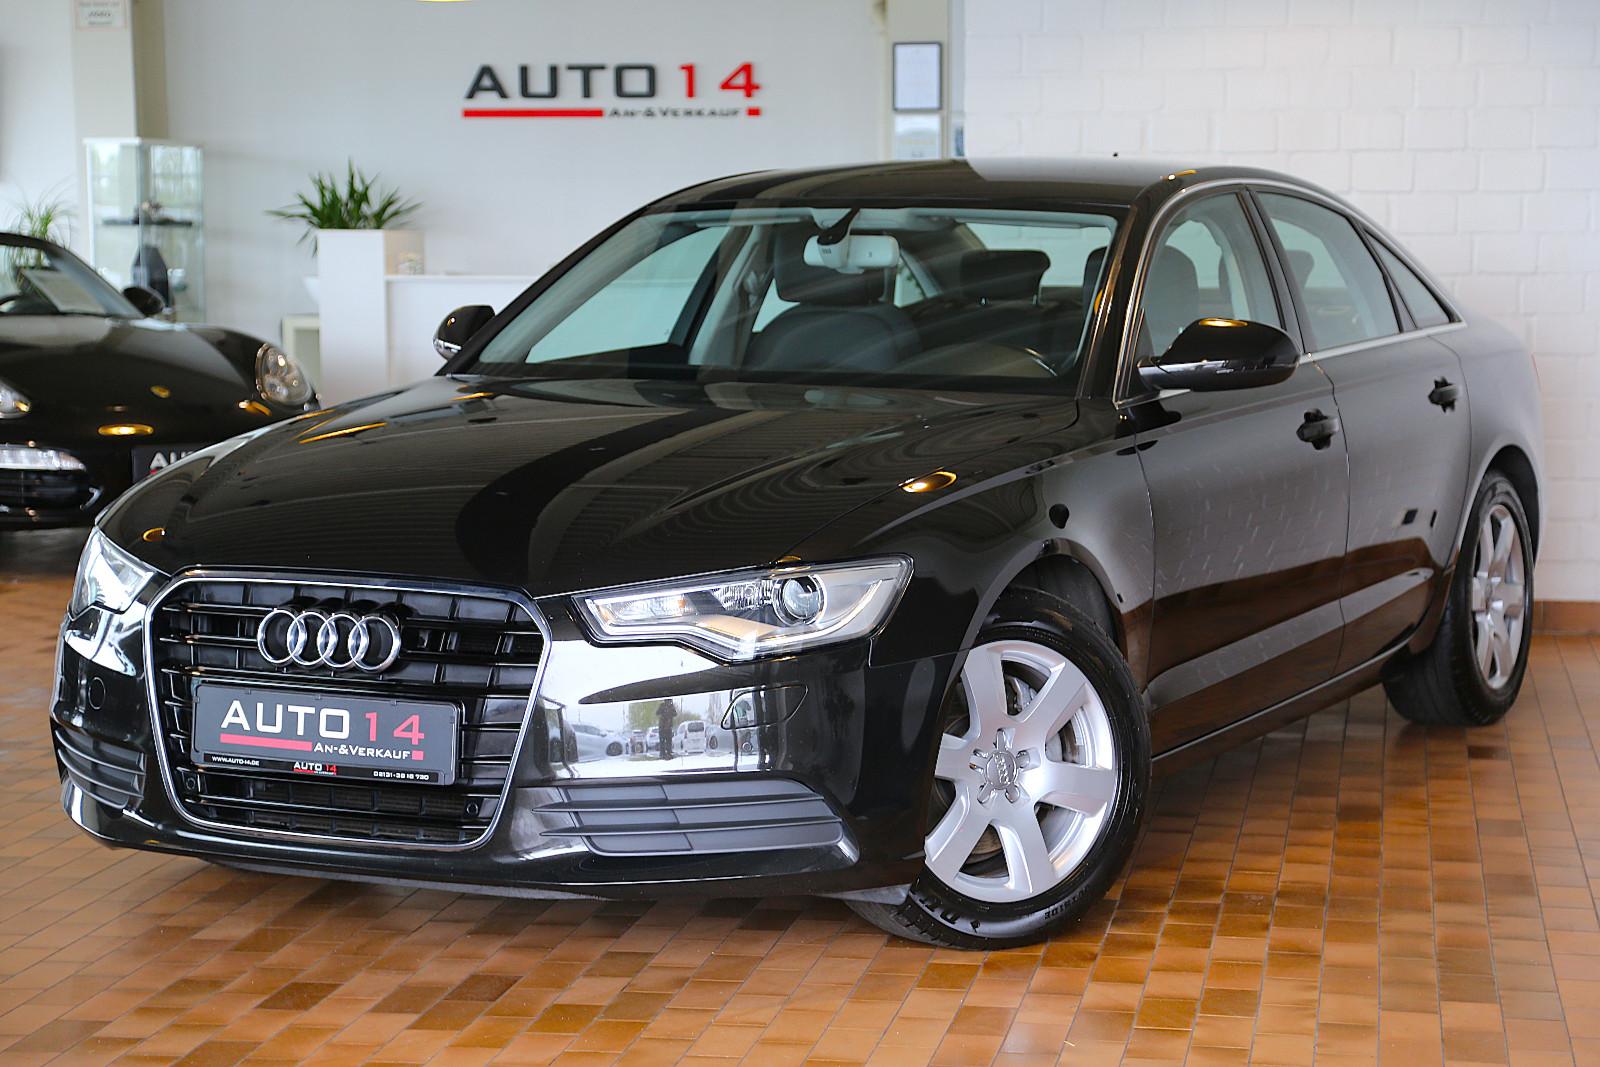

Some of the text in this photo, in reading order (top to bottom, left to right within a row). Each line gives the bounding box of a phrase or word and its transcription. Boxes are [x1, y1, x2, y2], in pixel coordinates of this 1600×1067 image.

[465, 61, 761, 99] AUTO 14
[220, 700, 425, 745] AUTO 14
[293, 761, 322, 771] AUTO
